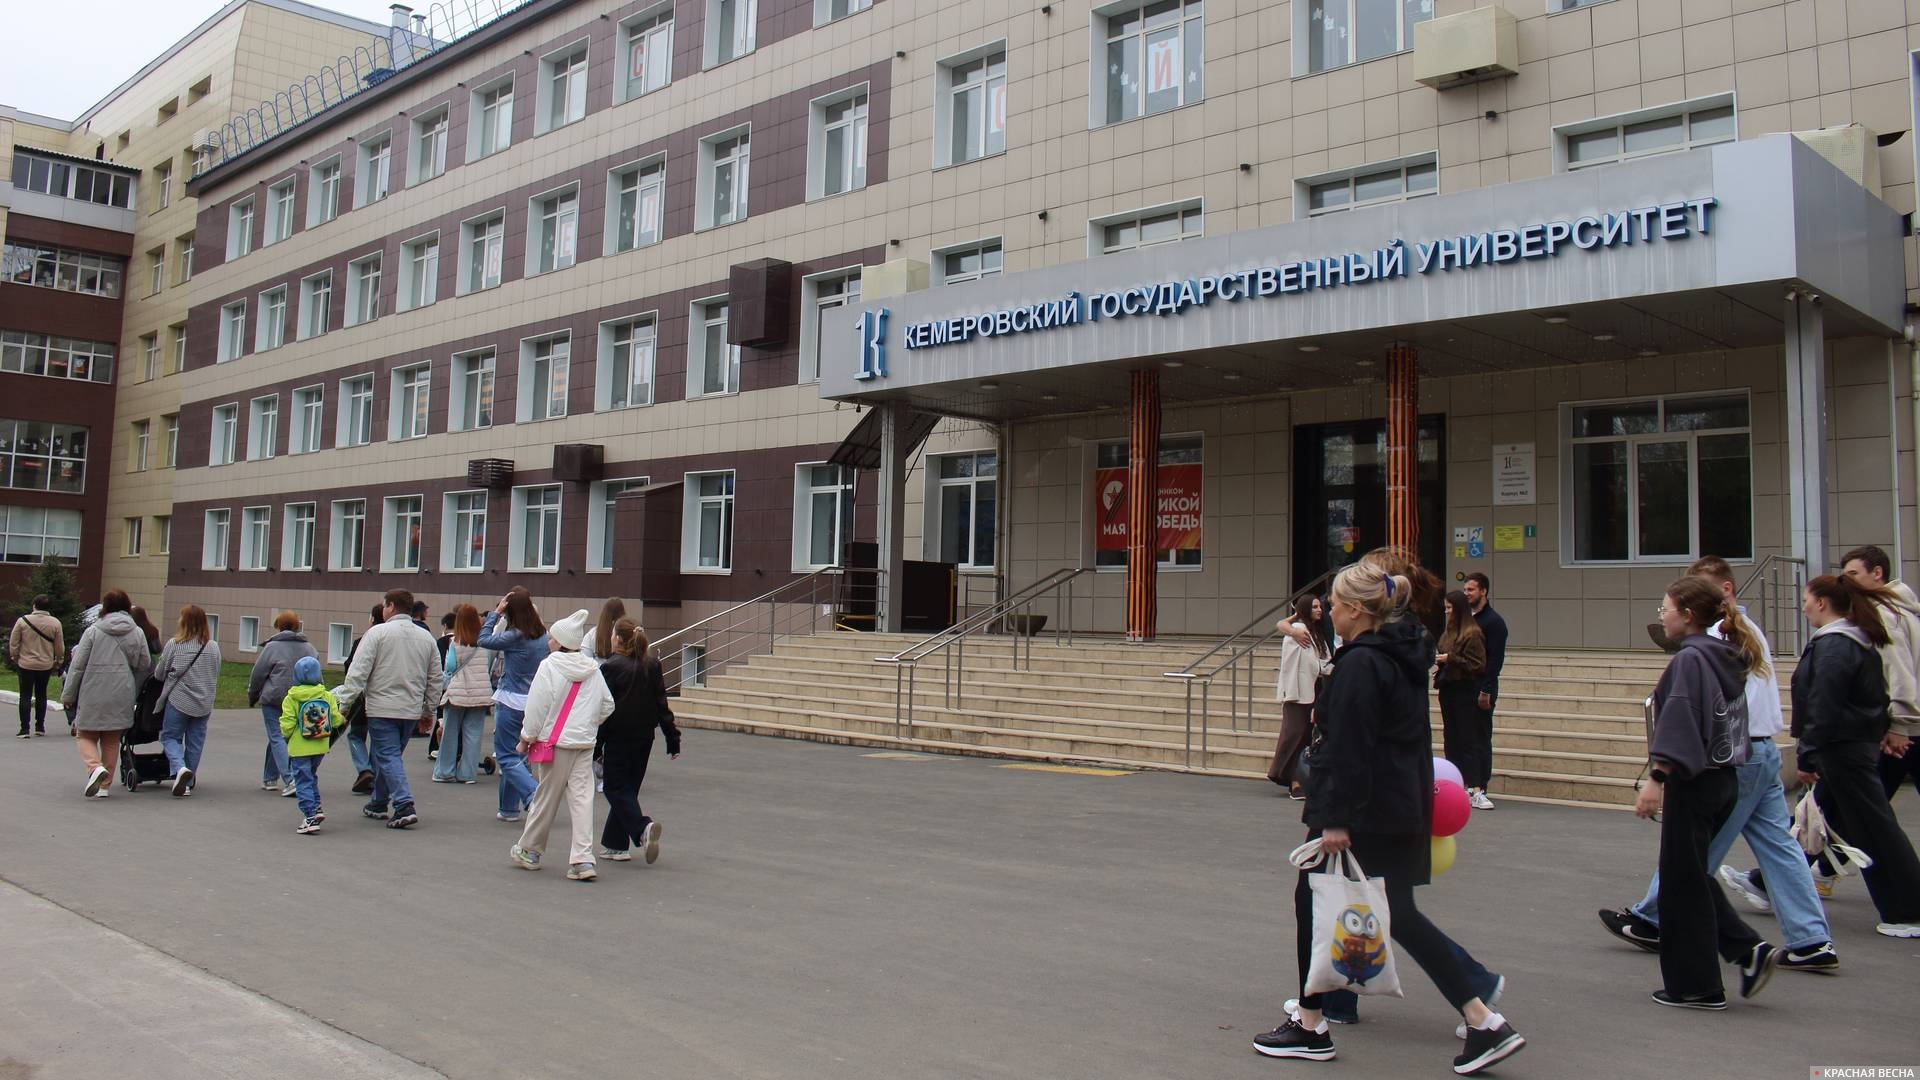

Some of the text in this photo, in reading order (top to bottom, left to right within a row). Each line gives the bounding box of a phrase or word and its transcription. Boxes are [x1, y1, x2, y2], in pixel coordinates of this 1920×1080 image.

[904, 197, 1717, 350] КЕМЕРОВСКИЙ ГОСУДАРСТВЕННЫЙ УНИВЕРСИТЕТ
[1158, 492, 1200, 512] ИКОЙ
[1103, 523, 1126, 535] МАЯ
